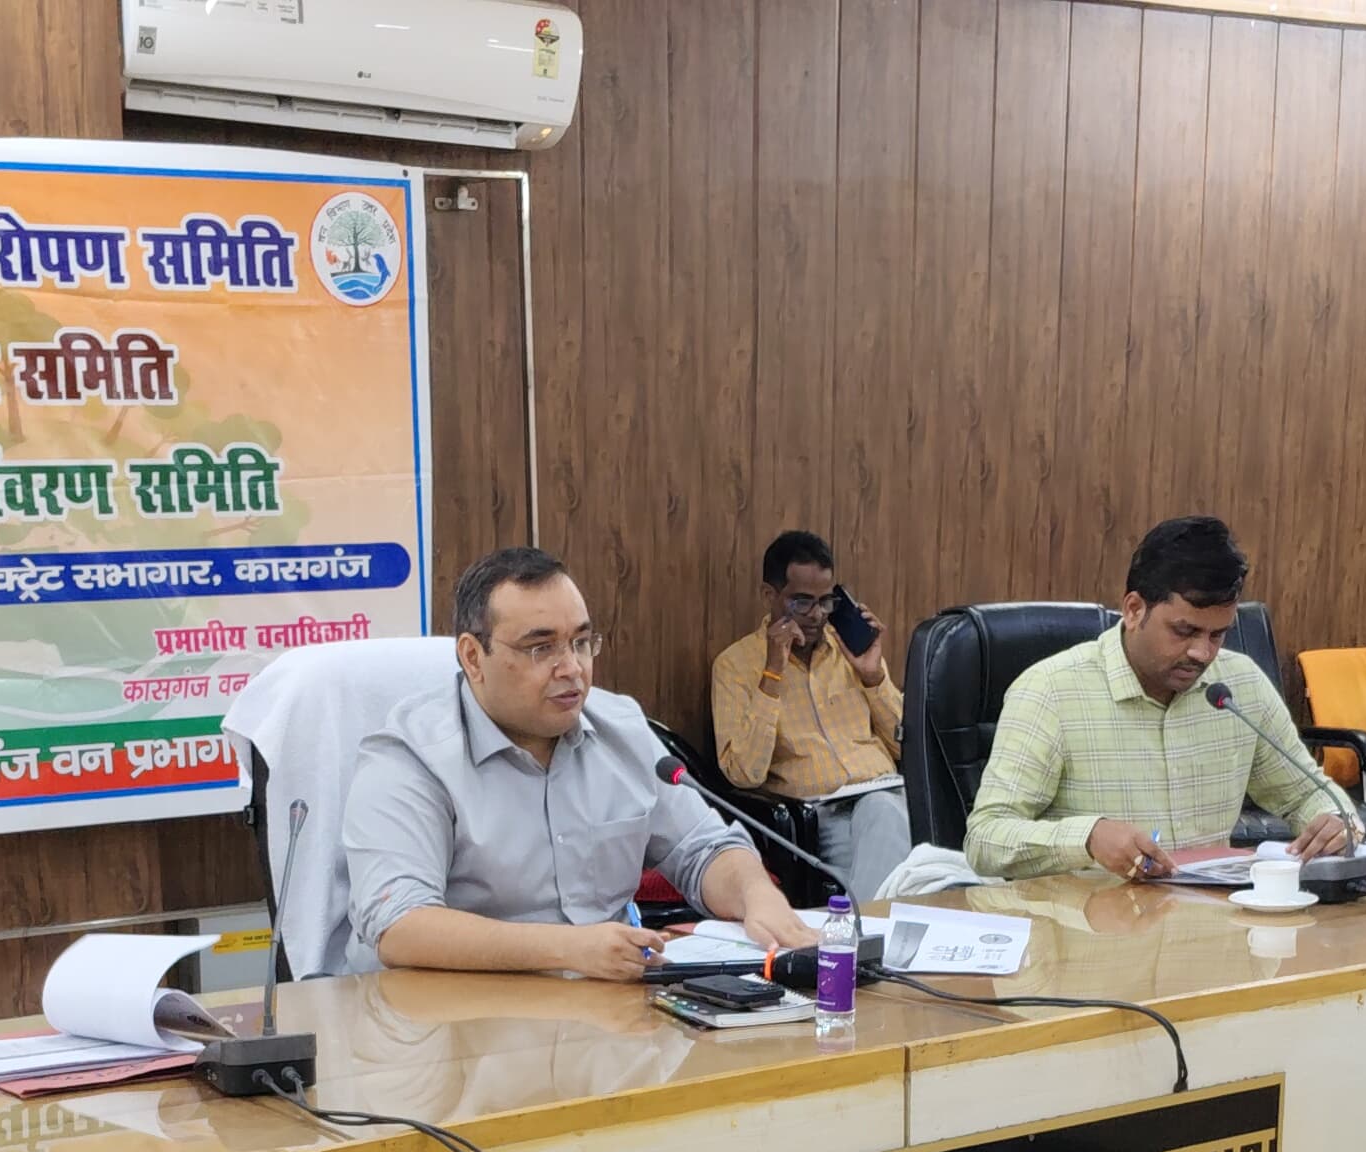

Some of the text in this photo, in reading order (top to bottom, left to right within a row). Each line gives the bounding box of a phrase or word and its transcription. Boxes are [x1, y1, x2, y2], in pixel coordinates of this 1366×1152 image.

[141, 218, 295, 288] समिति
[12, 332, 175, 401] समिति
[128, 448, 280, 514] समिति
[71, 560, 223, 591] सभागार,
[233, 547, 372, 584] कासगंज
[154, 612, 372, 656] प्रभागीय वनाधिकारी
[123, 668, 212, 703] कासगंज
[49, 741, 116, 777] वन
[123, 733, 233, 779] प्रभाग
